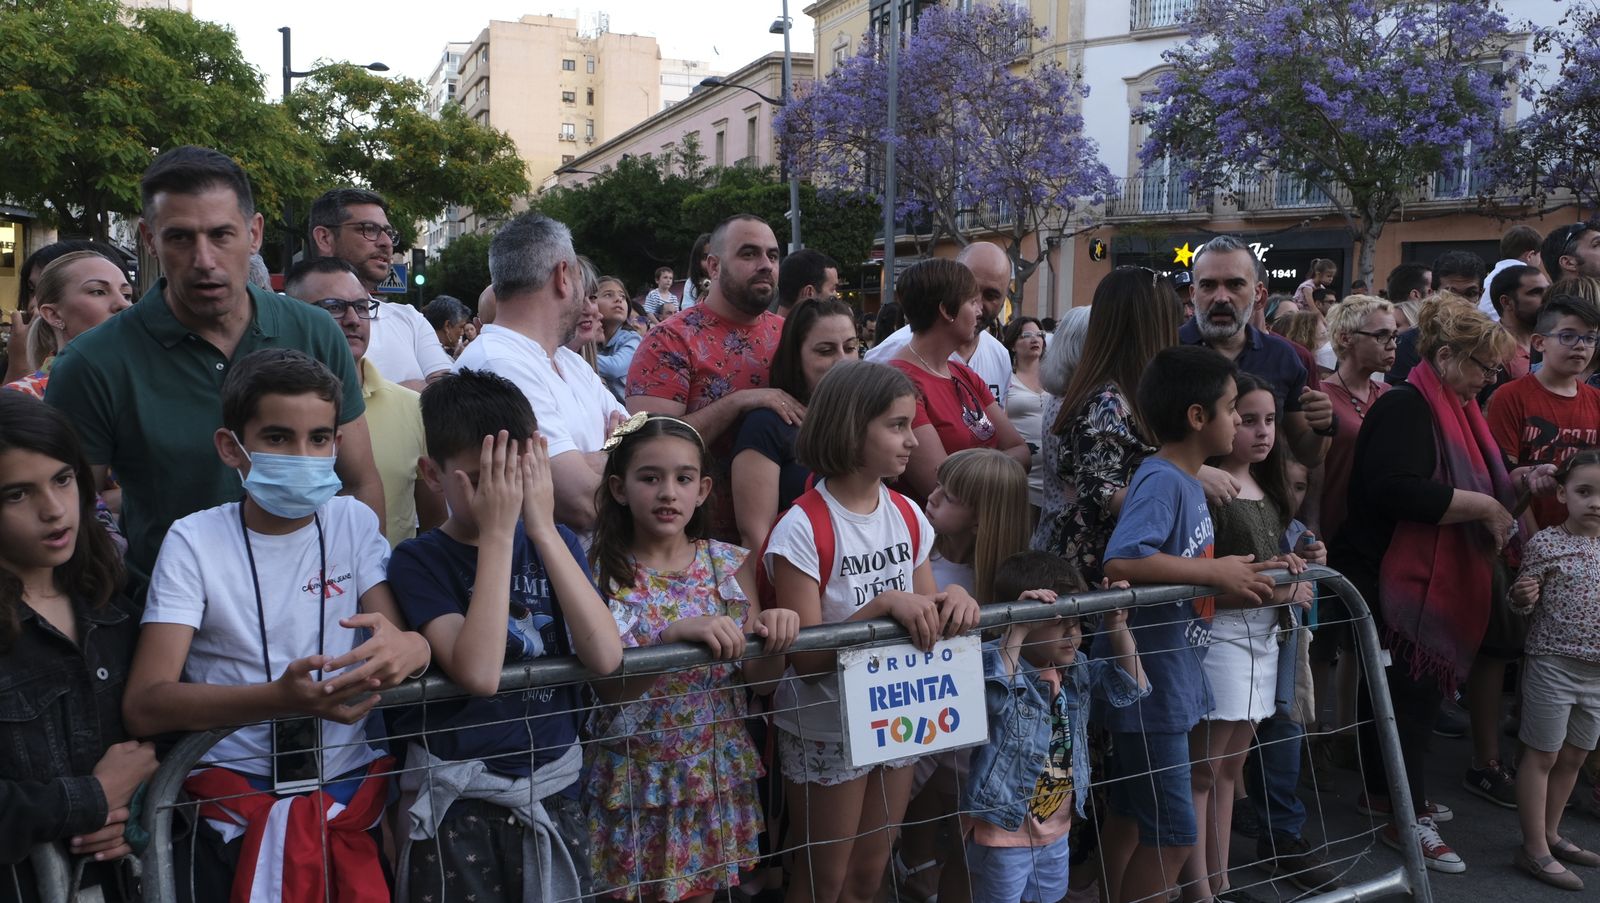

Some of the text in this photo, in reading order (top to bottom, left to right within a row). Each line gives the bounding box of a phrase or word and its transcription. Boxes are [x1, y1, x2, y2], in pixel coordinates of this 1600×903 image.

[1271, 268, 1297, 279] 1941
[840, 542, 911, 577] AMOUR
[337, 573, 352, 583] JEANS
[867, 648, 953, 674] GRUPO
[868, 674, 959, 712] RENTA
[871, 706, 960, 748] TODO
